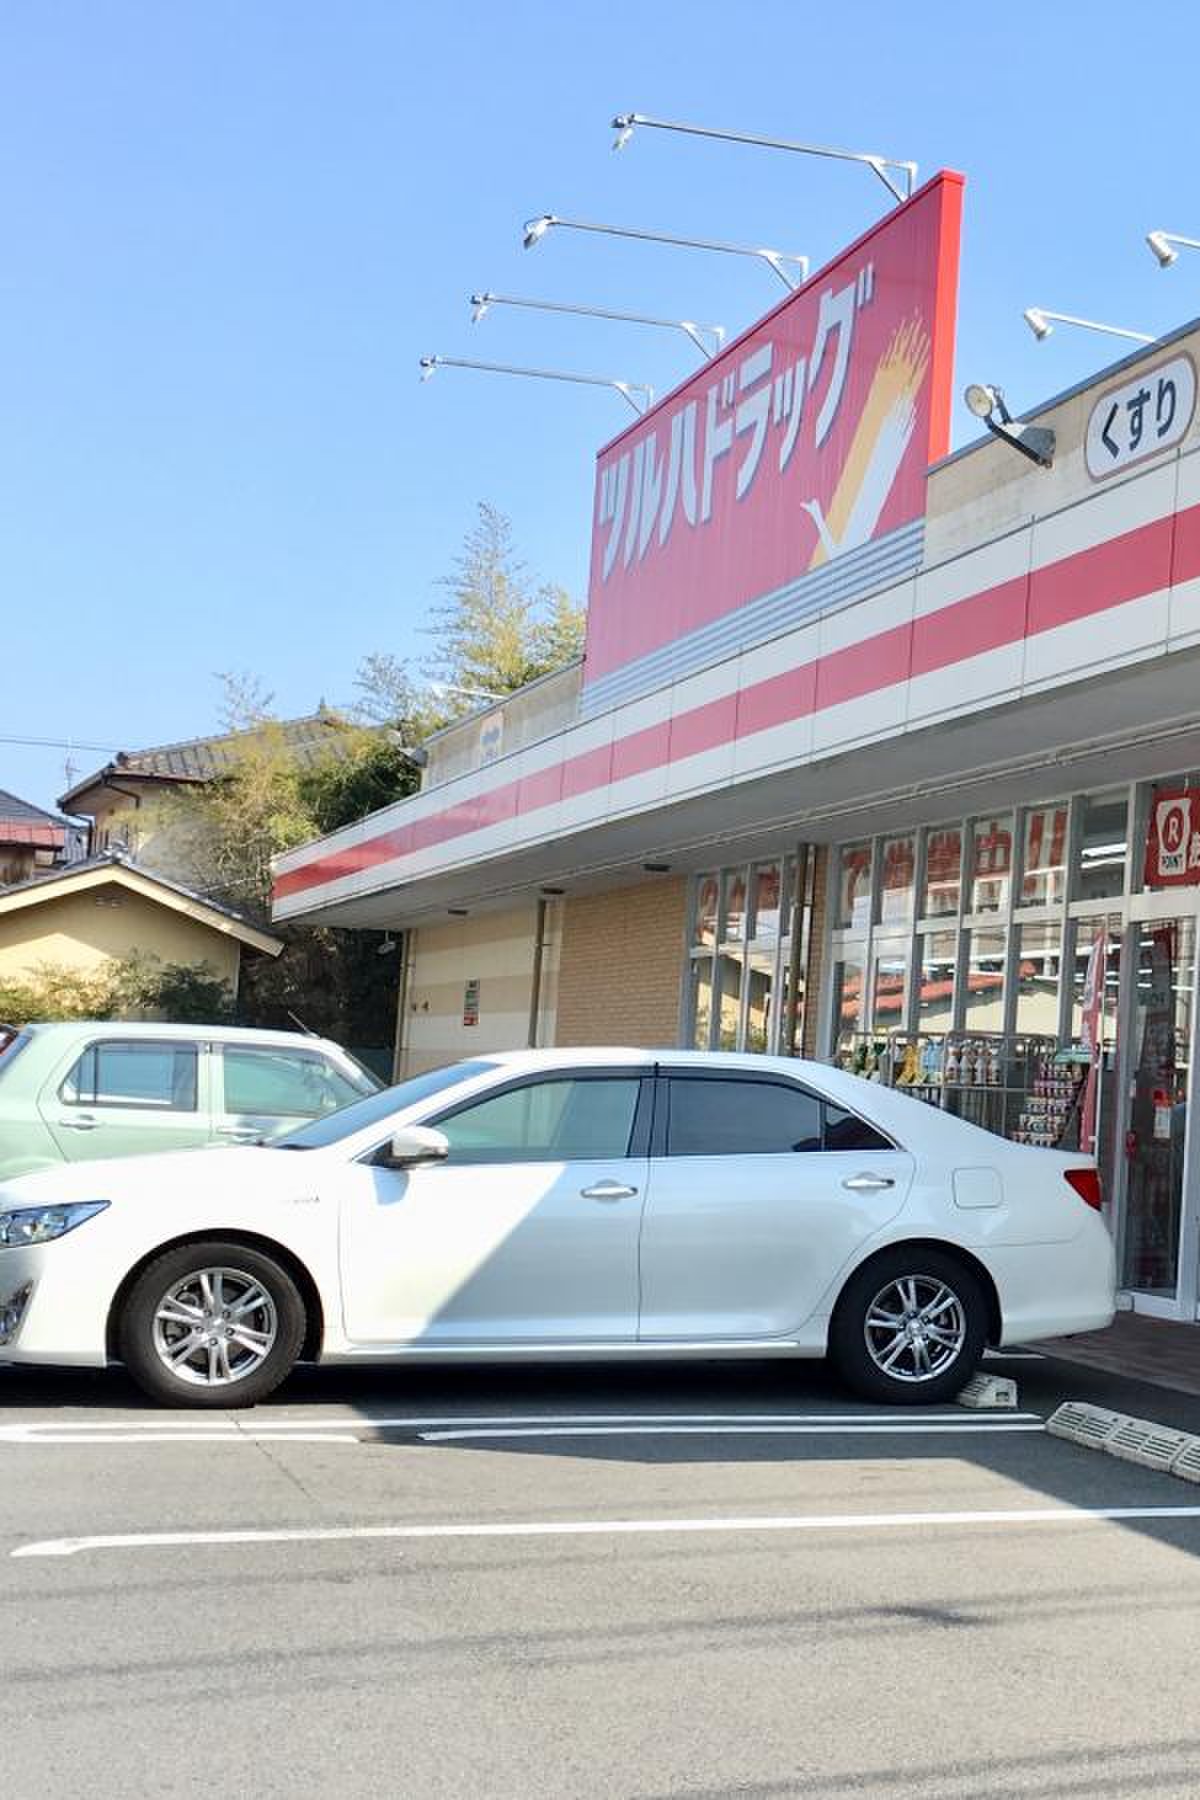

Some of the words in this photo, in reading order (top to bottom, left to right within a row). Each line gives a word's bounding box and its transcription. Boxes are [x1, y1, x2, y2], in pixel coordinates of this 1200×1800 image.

[600, 262, 875, 583] ツルハドラッグ
[1101, 378, 1177, 459] くすり
